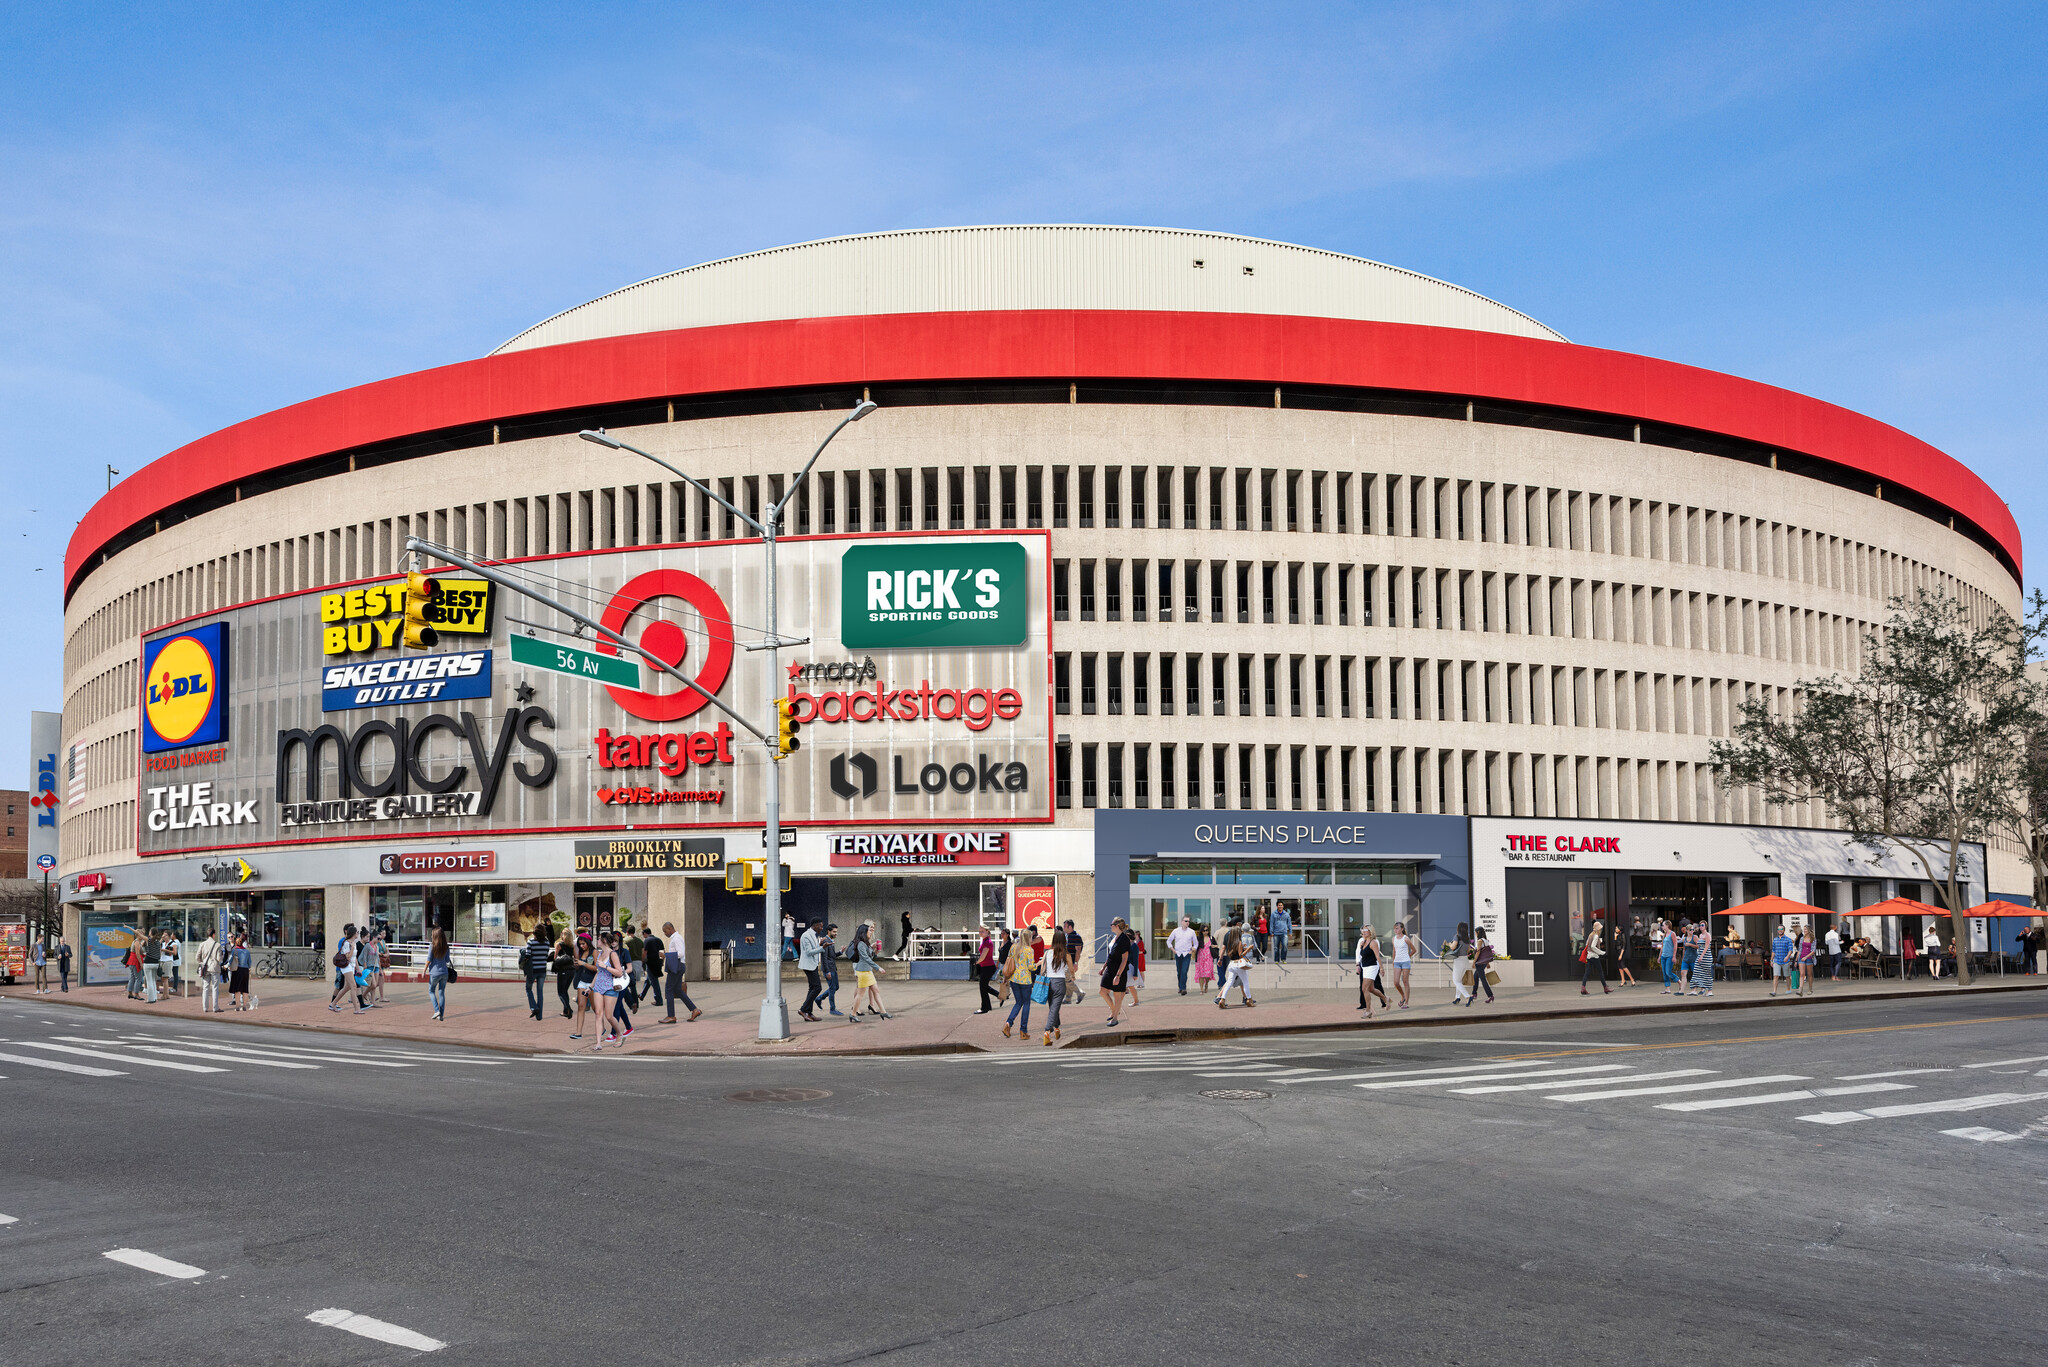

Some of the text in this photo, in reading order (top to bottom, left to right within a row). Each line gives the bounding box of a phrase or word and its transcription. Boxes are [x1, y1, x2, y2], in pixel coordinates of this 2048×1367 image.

[431, 590, 487, 608] BEST
[867, 568, 1000, 611] RICK'S
[321, 583, 409, 623] BEST
[868, 610, 999, 622] SPORTING GOODS
[323, 618, 405, 655] BUY
[323, 653, 485, 690] SKECHERS
[556, 649, 599, 675] 56 Av
[354, 681, 446, 704] OUTLET
[788, 680, 1023, 731] backstage
[146, 748, 226, 772] FOOD MARKET
[594, 722, 734, 777] target
[894, 753, 1029, 794] Looka
[147, 782, 213, 810] THE
[614, 786, 724, 806] CVS pharmacy
[147, 799, 259, 832] CLARK
[281, 793, 475, 824] FURNITURE GALLERY
[781, 834, 793, 842] WAY
[827, 832, 1002, 854] TERIYAKI ONE
[1194, 824, 1367, 844] QUEENS PLACE
[1506, 834, 1621, 853] THE CLARK
[608, 840, 682, 853] BROOKLYN
[1508, 853, 1523, 861] BAR
[1531, 853, 1576, 862] RESTAURANT
[402, 855, 489, 870] CHIPOTLE
[575, 853, 720, 870] DUMPLING SHOP
[860, 854, 955, 864] JAPANESE GRILL
[201, 861, 238, 884] Sprint
[96, 929, 116, 937] cool
[98, 933, 124, 943] pools
